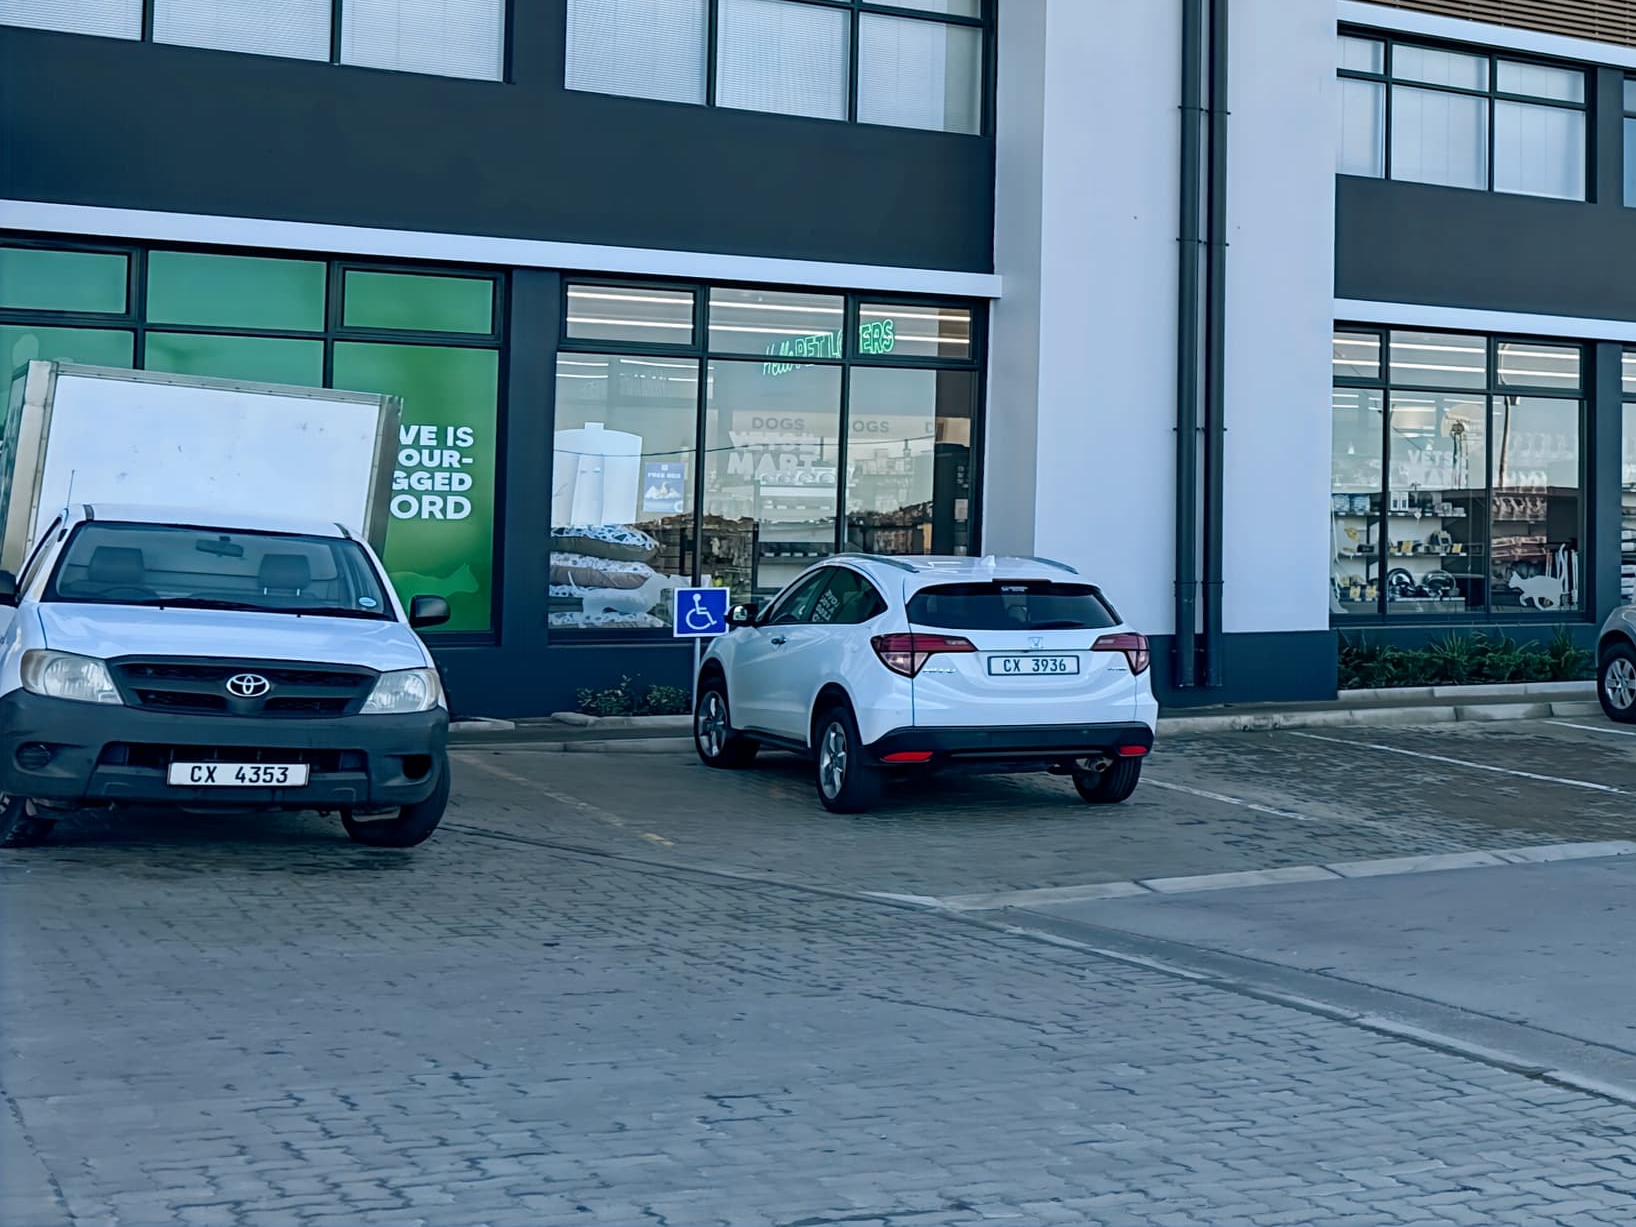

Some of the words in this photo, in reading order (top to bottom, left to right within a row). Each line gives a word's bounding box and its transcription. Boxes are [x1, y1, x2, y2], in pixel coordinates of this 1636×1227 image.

[752, 416, 805, 431] DOGS
[852, 419, 890, 434] OGS
[399, 424, 438, 446] VE
[446, 426, 474, 448] IS
[398, 448, 474, 468] OUR-
[392, 470, 473, 492] GGED
[390, 494, 472, 520] ORD
[1003, 659, 1021, 673] CX
[1031, 659, 1067, 673] 3936
[190, 765, 218, 784] CX
[235, 766, 290, 784] 4353
